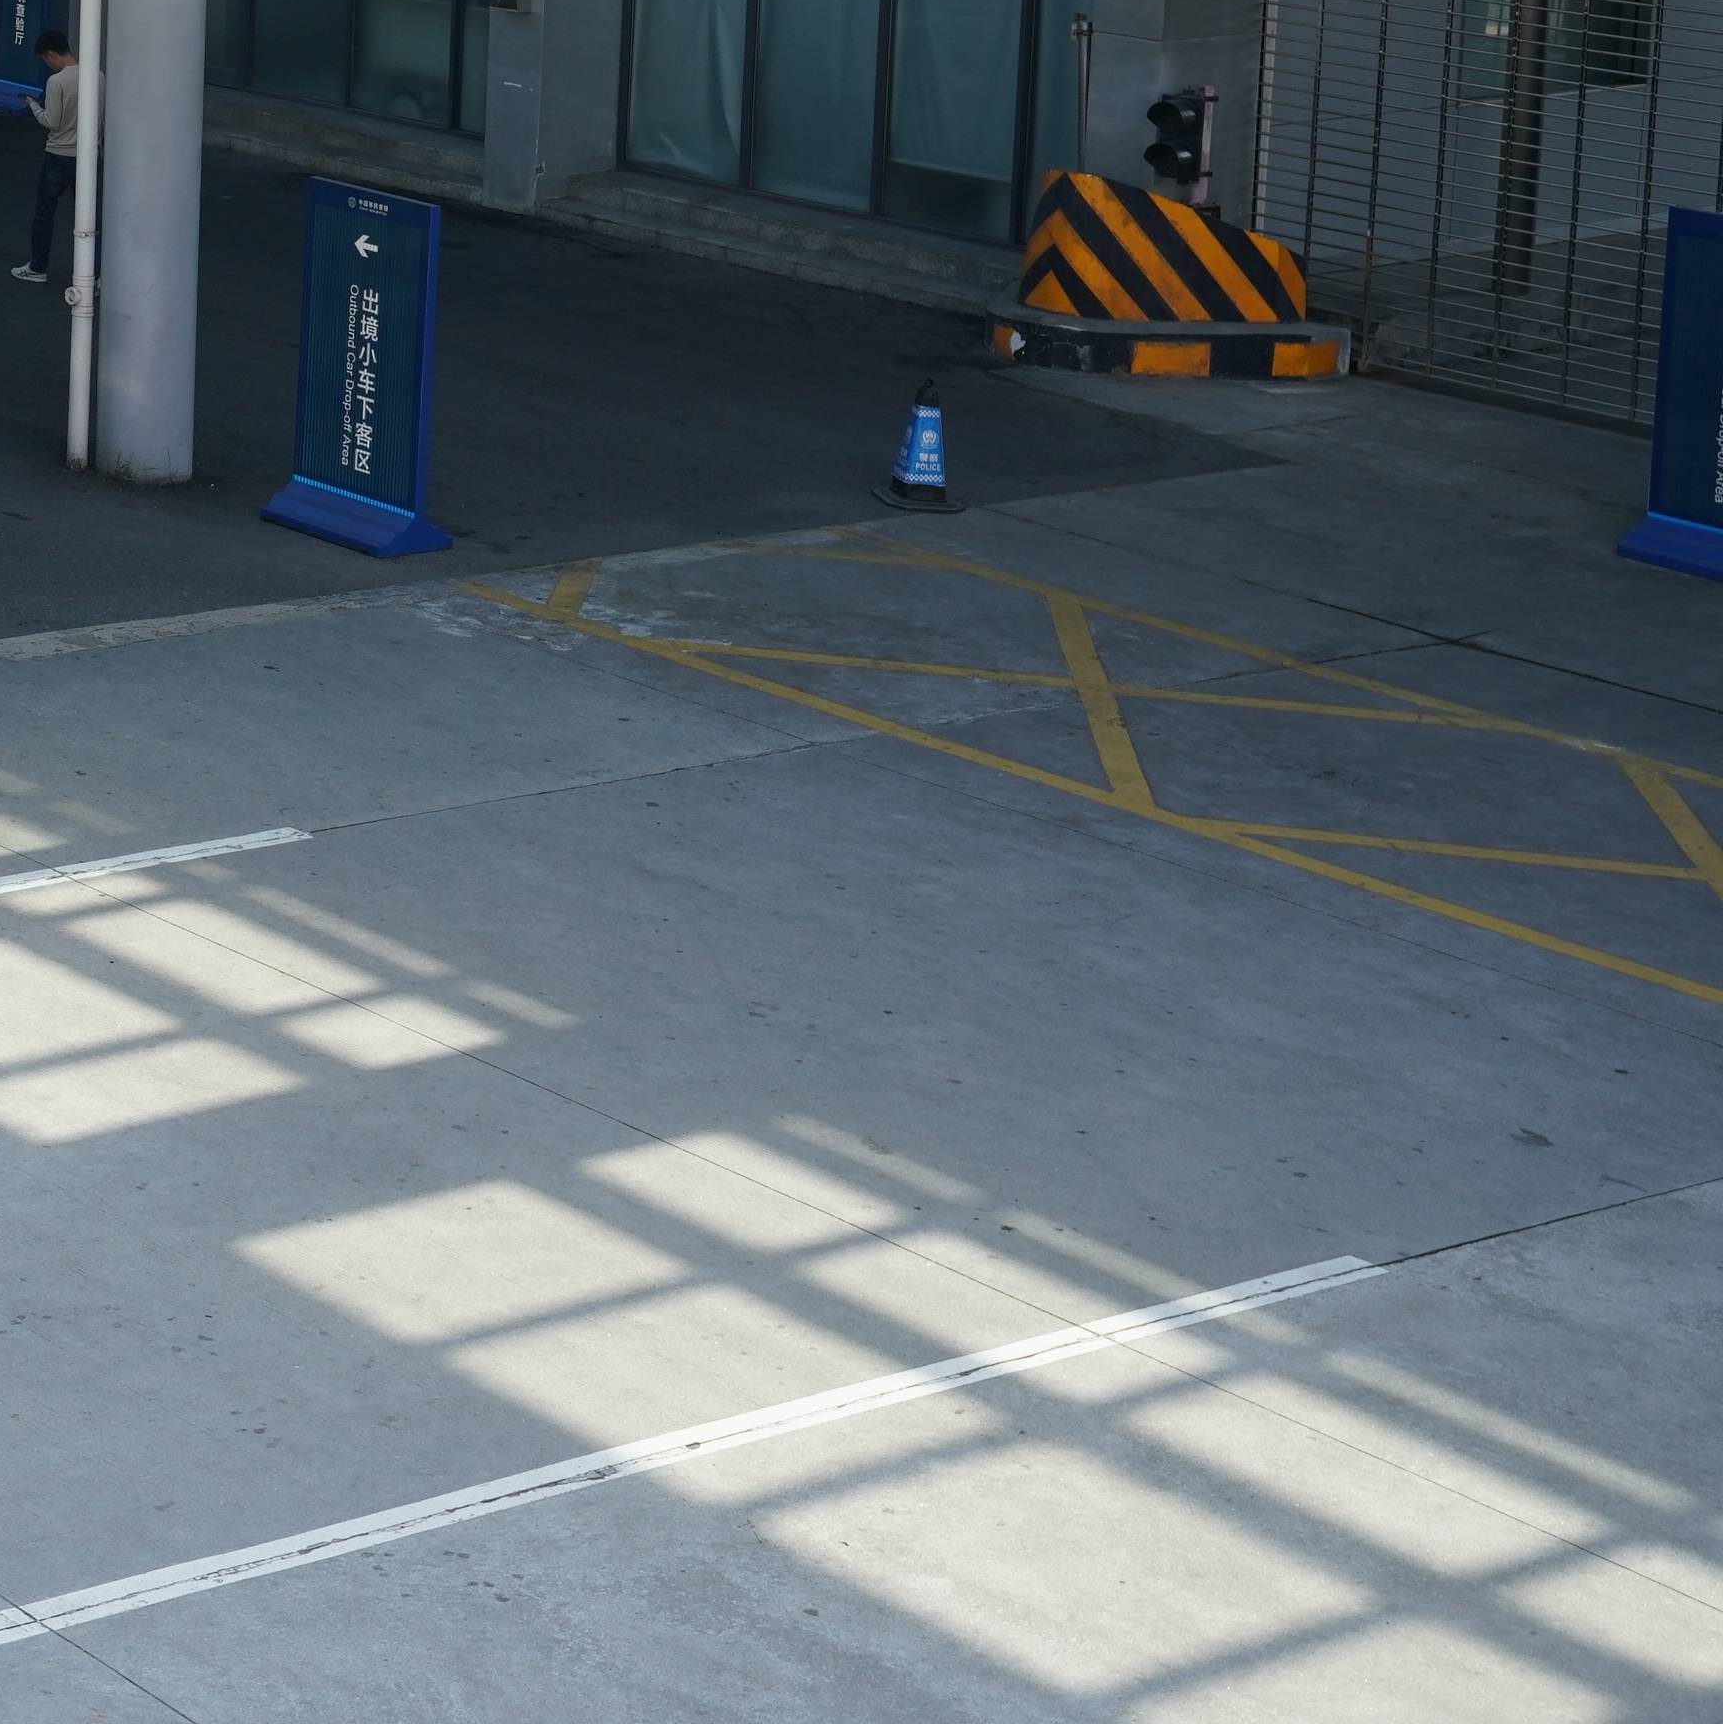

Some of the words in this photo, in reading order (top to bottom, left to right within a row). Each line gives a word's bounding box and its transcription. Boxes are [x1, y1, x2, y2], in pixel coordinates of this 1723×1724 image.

[348, 284, 359, 348] Outbound
[346, 352, 356, 376] Car
[355, 288, 379, 474] 出境小车下客区
[342, 379, 354, 433] Drop-off
[341, 434, 352, 466] Area
[915, 462, 941, 471] POLICE
